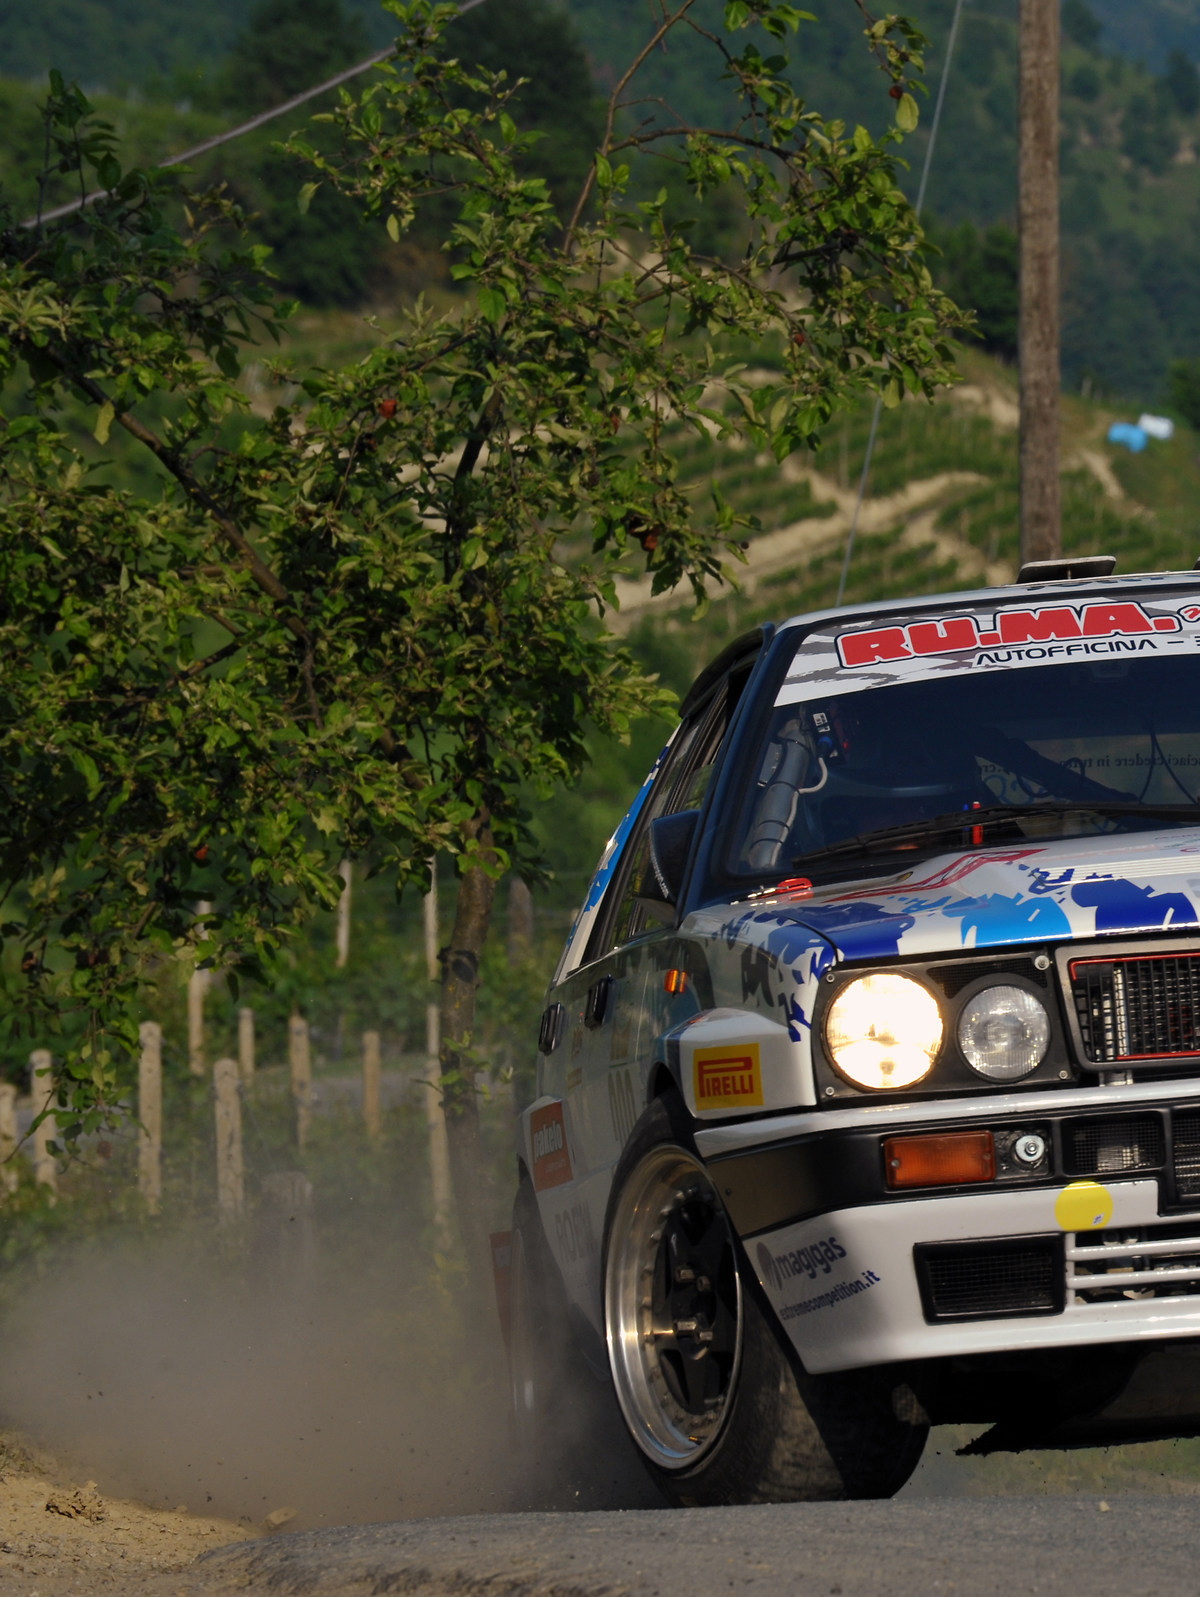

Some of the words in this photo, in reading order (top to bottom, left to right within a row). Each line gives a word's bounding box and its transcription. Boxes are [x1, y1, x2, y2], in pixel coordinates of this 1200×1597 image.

[835, 601, 1182, 668] RU.MA.
[975, 639, 1159, 666] AUTOFFICINA
[698, 1056, 754, 1098] PIRELLI
[775, 1236, 847, 1279] magigas
[779, 1270, 881, 1320] extremecompetition.it
